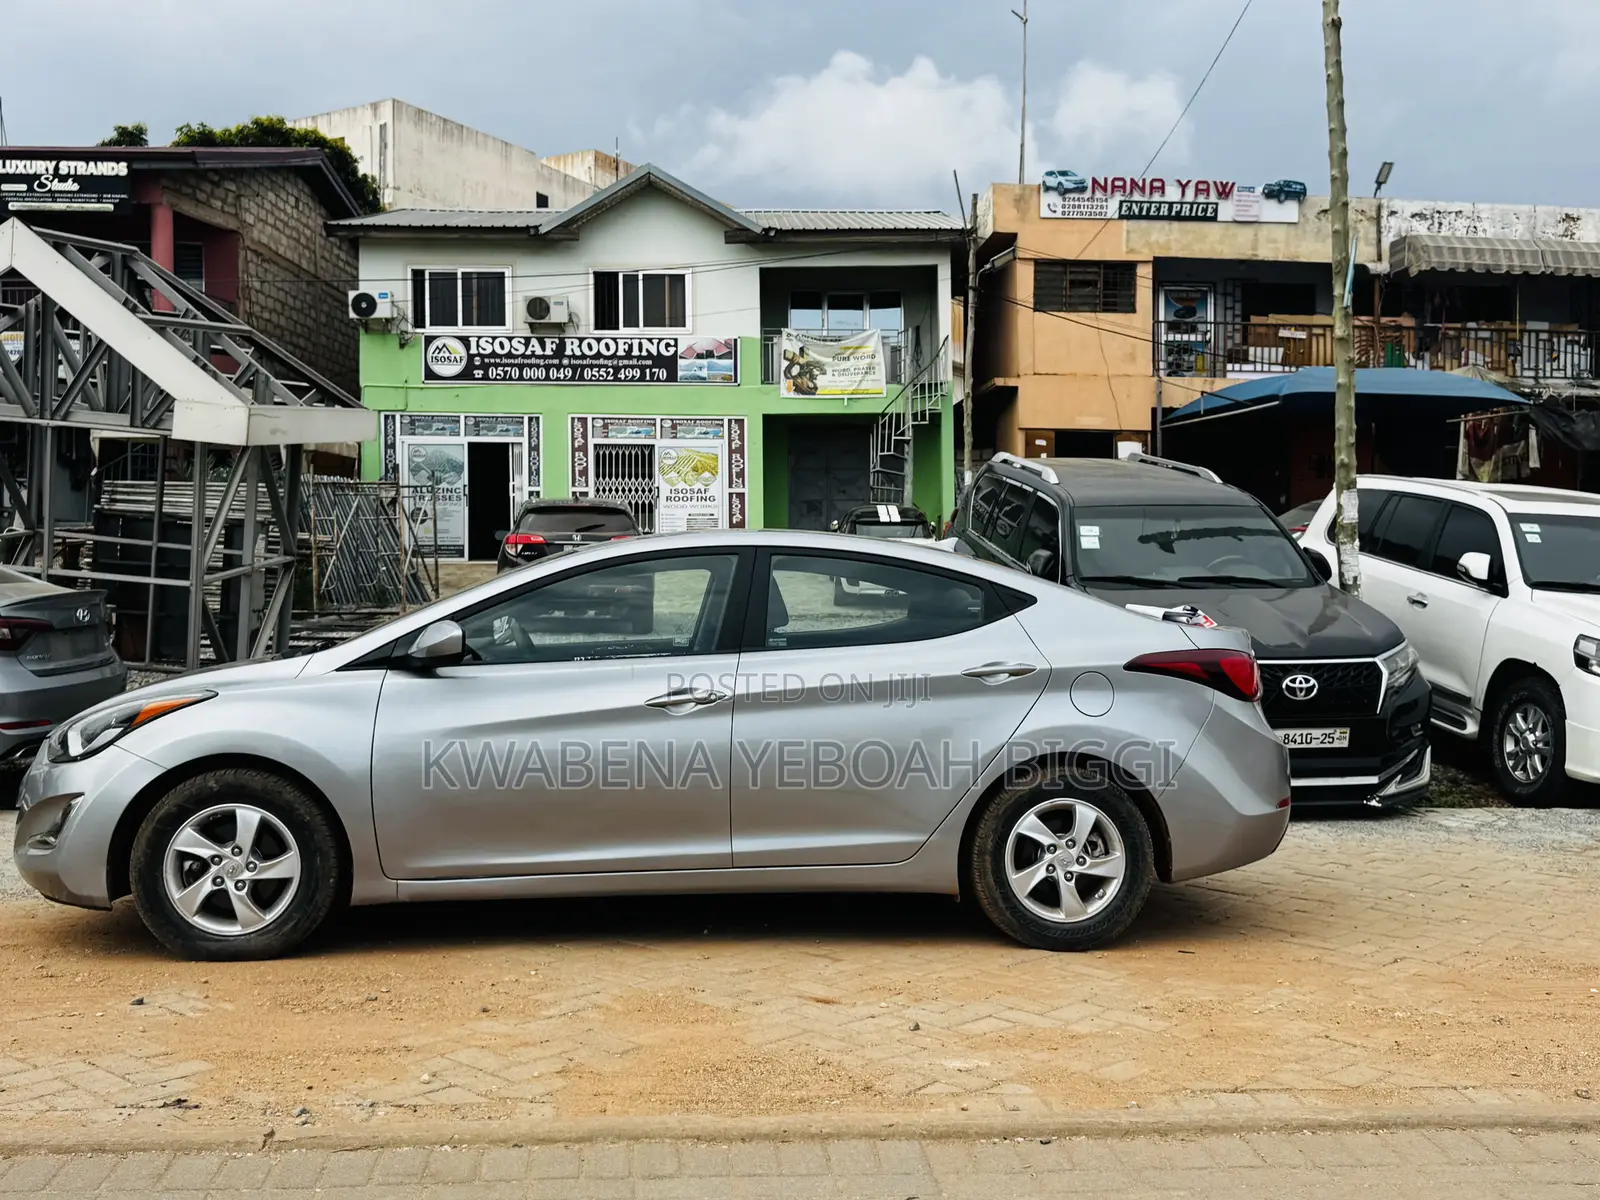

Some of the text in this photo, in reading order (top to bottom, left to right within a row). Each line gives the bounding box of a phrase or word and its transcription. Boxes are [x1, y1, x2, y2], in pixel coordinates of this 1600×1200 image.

[0, 160, 128, 176] LUXURY STRANDS
[33, 174, 80, 192] Studio
[1091, 177, 1236, 199] NANA YAW
[1120, 202, 1217, 218] ENTERPRICE
[468, 336, 677, 357] ISOSAF ROOFING
[430, 355, 465, 364] ISOSAF
[488, 366, 668, 381] 0570 000 049 / 0552 499 170
[386, 448, 396, 481] ROOFIN
[669, 487, 710, 495] ISOSAF
[1282, 732, 1335, 745] 8410-25
